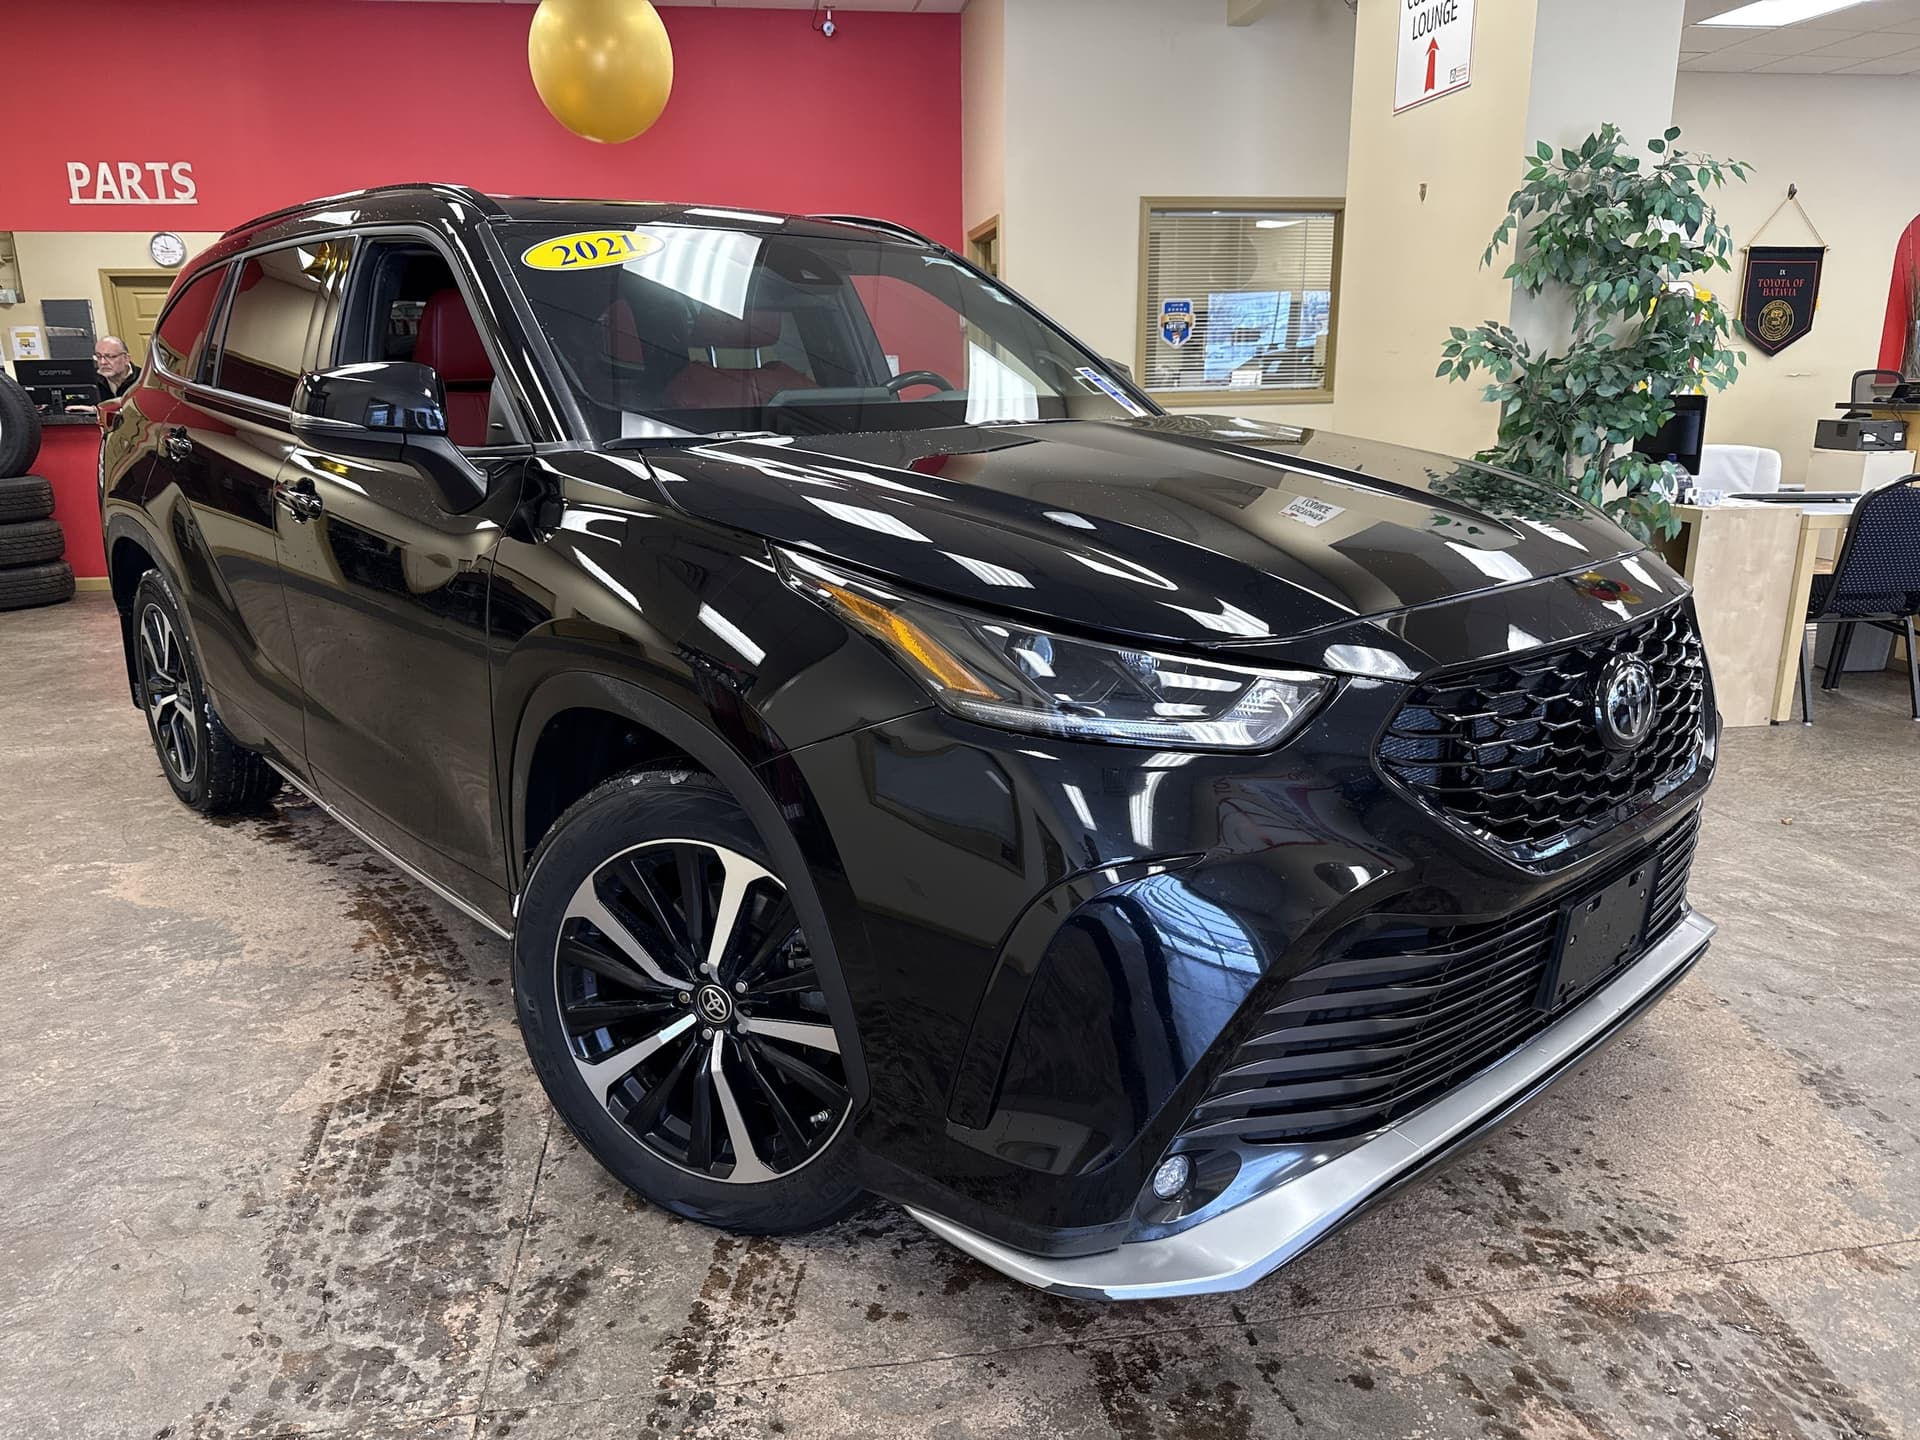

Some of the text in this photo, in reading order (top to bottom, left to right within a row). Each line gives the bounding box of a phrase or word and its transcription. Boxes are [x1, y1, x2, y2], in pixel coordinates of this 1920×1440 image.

[1412, 0, 1458, 40] LOUNGE
[66, 161, 197, 203] PARTS
[552, 234, 639, 266] 2021
[1757, 278, 1805, 288] TOYOTA OF
[1762, 287, 1797, 297] BATAVIA
